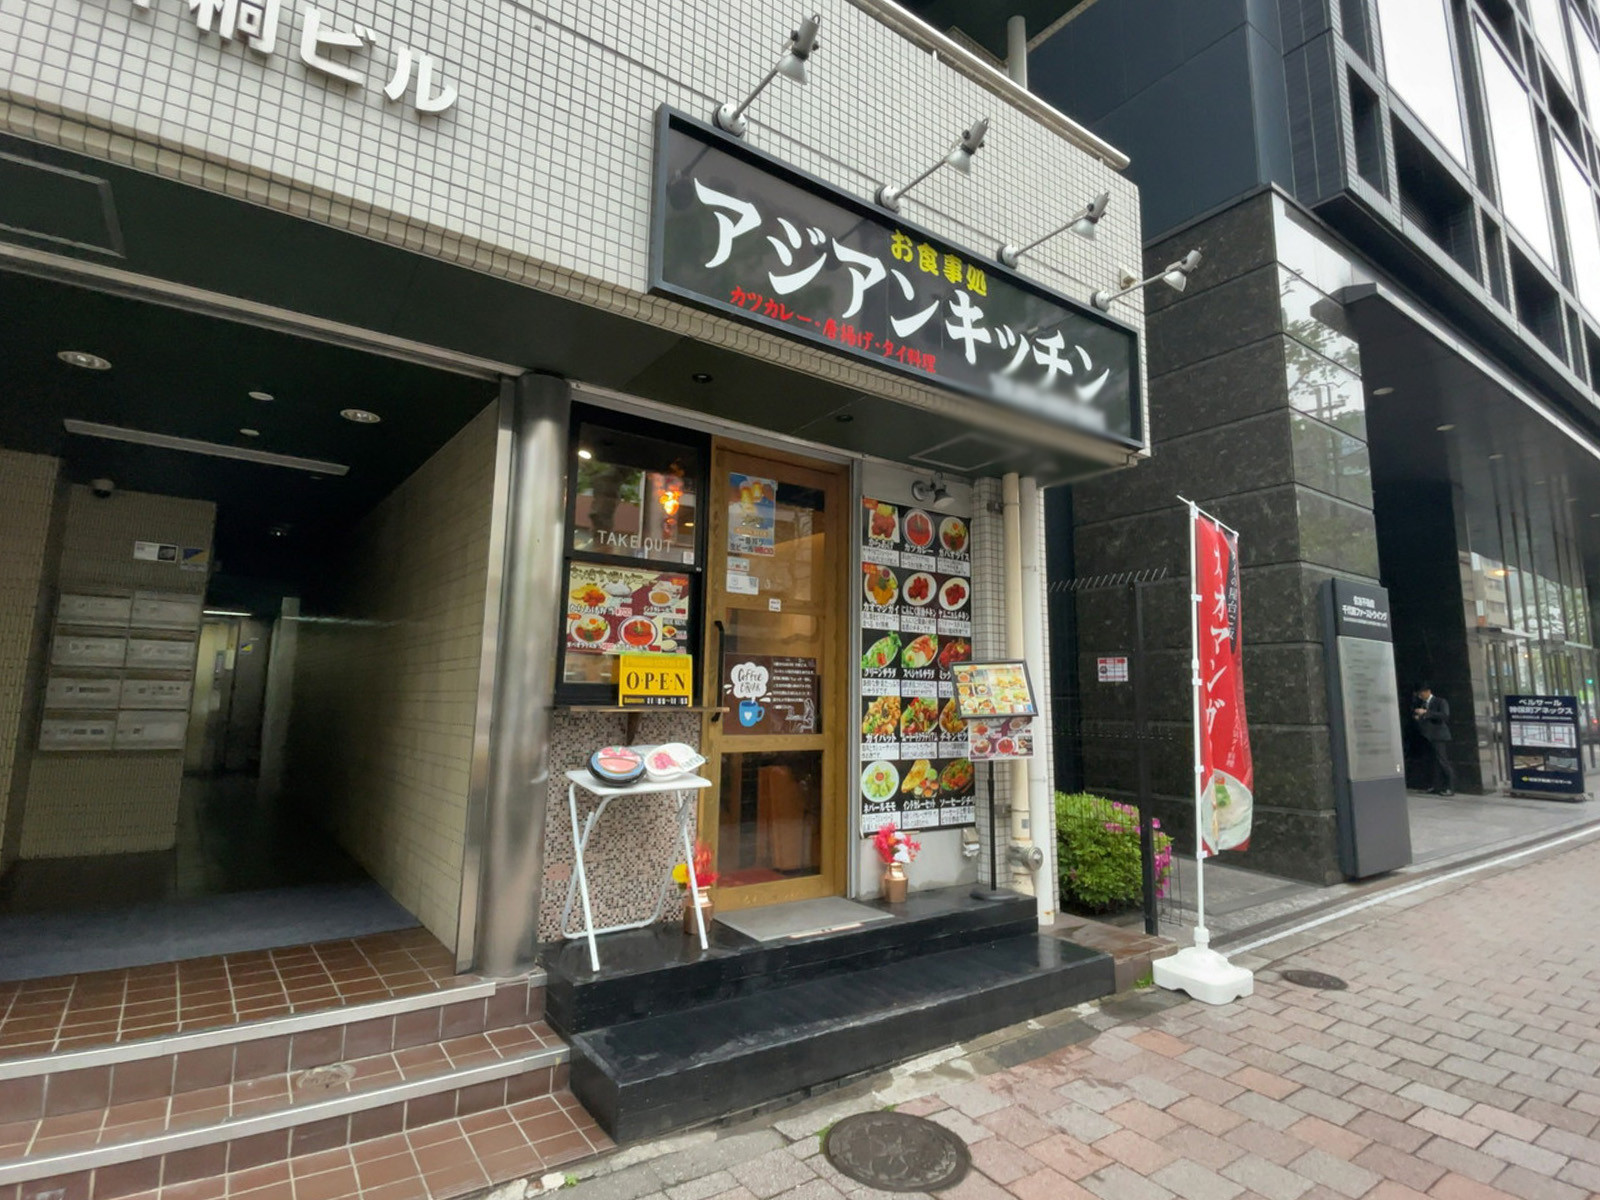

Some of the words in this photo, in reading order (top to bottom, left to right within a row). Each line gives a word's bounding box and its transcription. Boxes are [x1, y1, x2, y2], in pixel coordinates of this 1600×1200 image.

[890, 228, 989, 297] お食事処
[693, 177, 1111, 402] アジアンキッチン
[597, 530, 639, 549] TAKE
[643, 536, 673, 554] OUT
[904, 543, 934, 554] カツカレー
[863, 601, 900, 614] カオマンガイ
[1518, 698, 1563, 707] ベルサール
